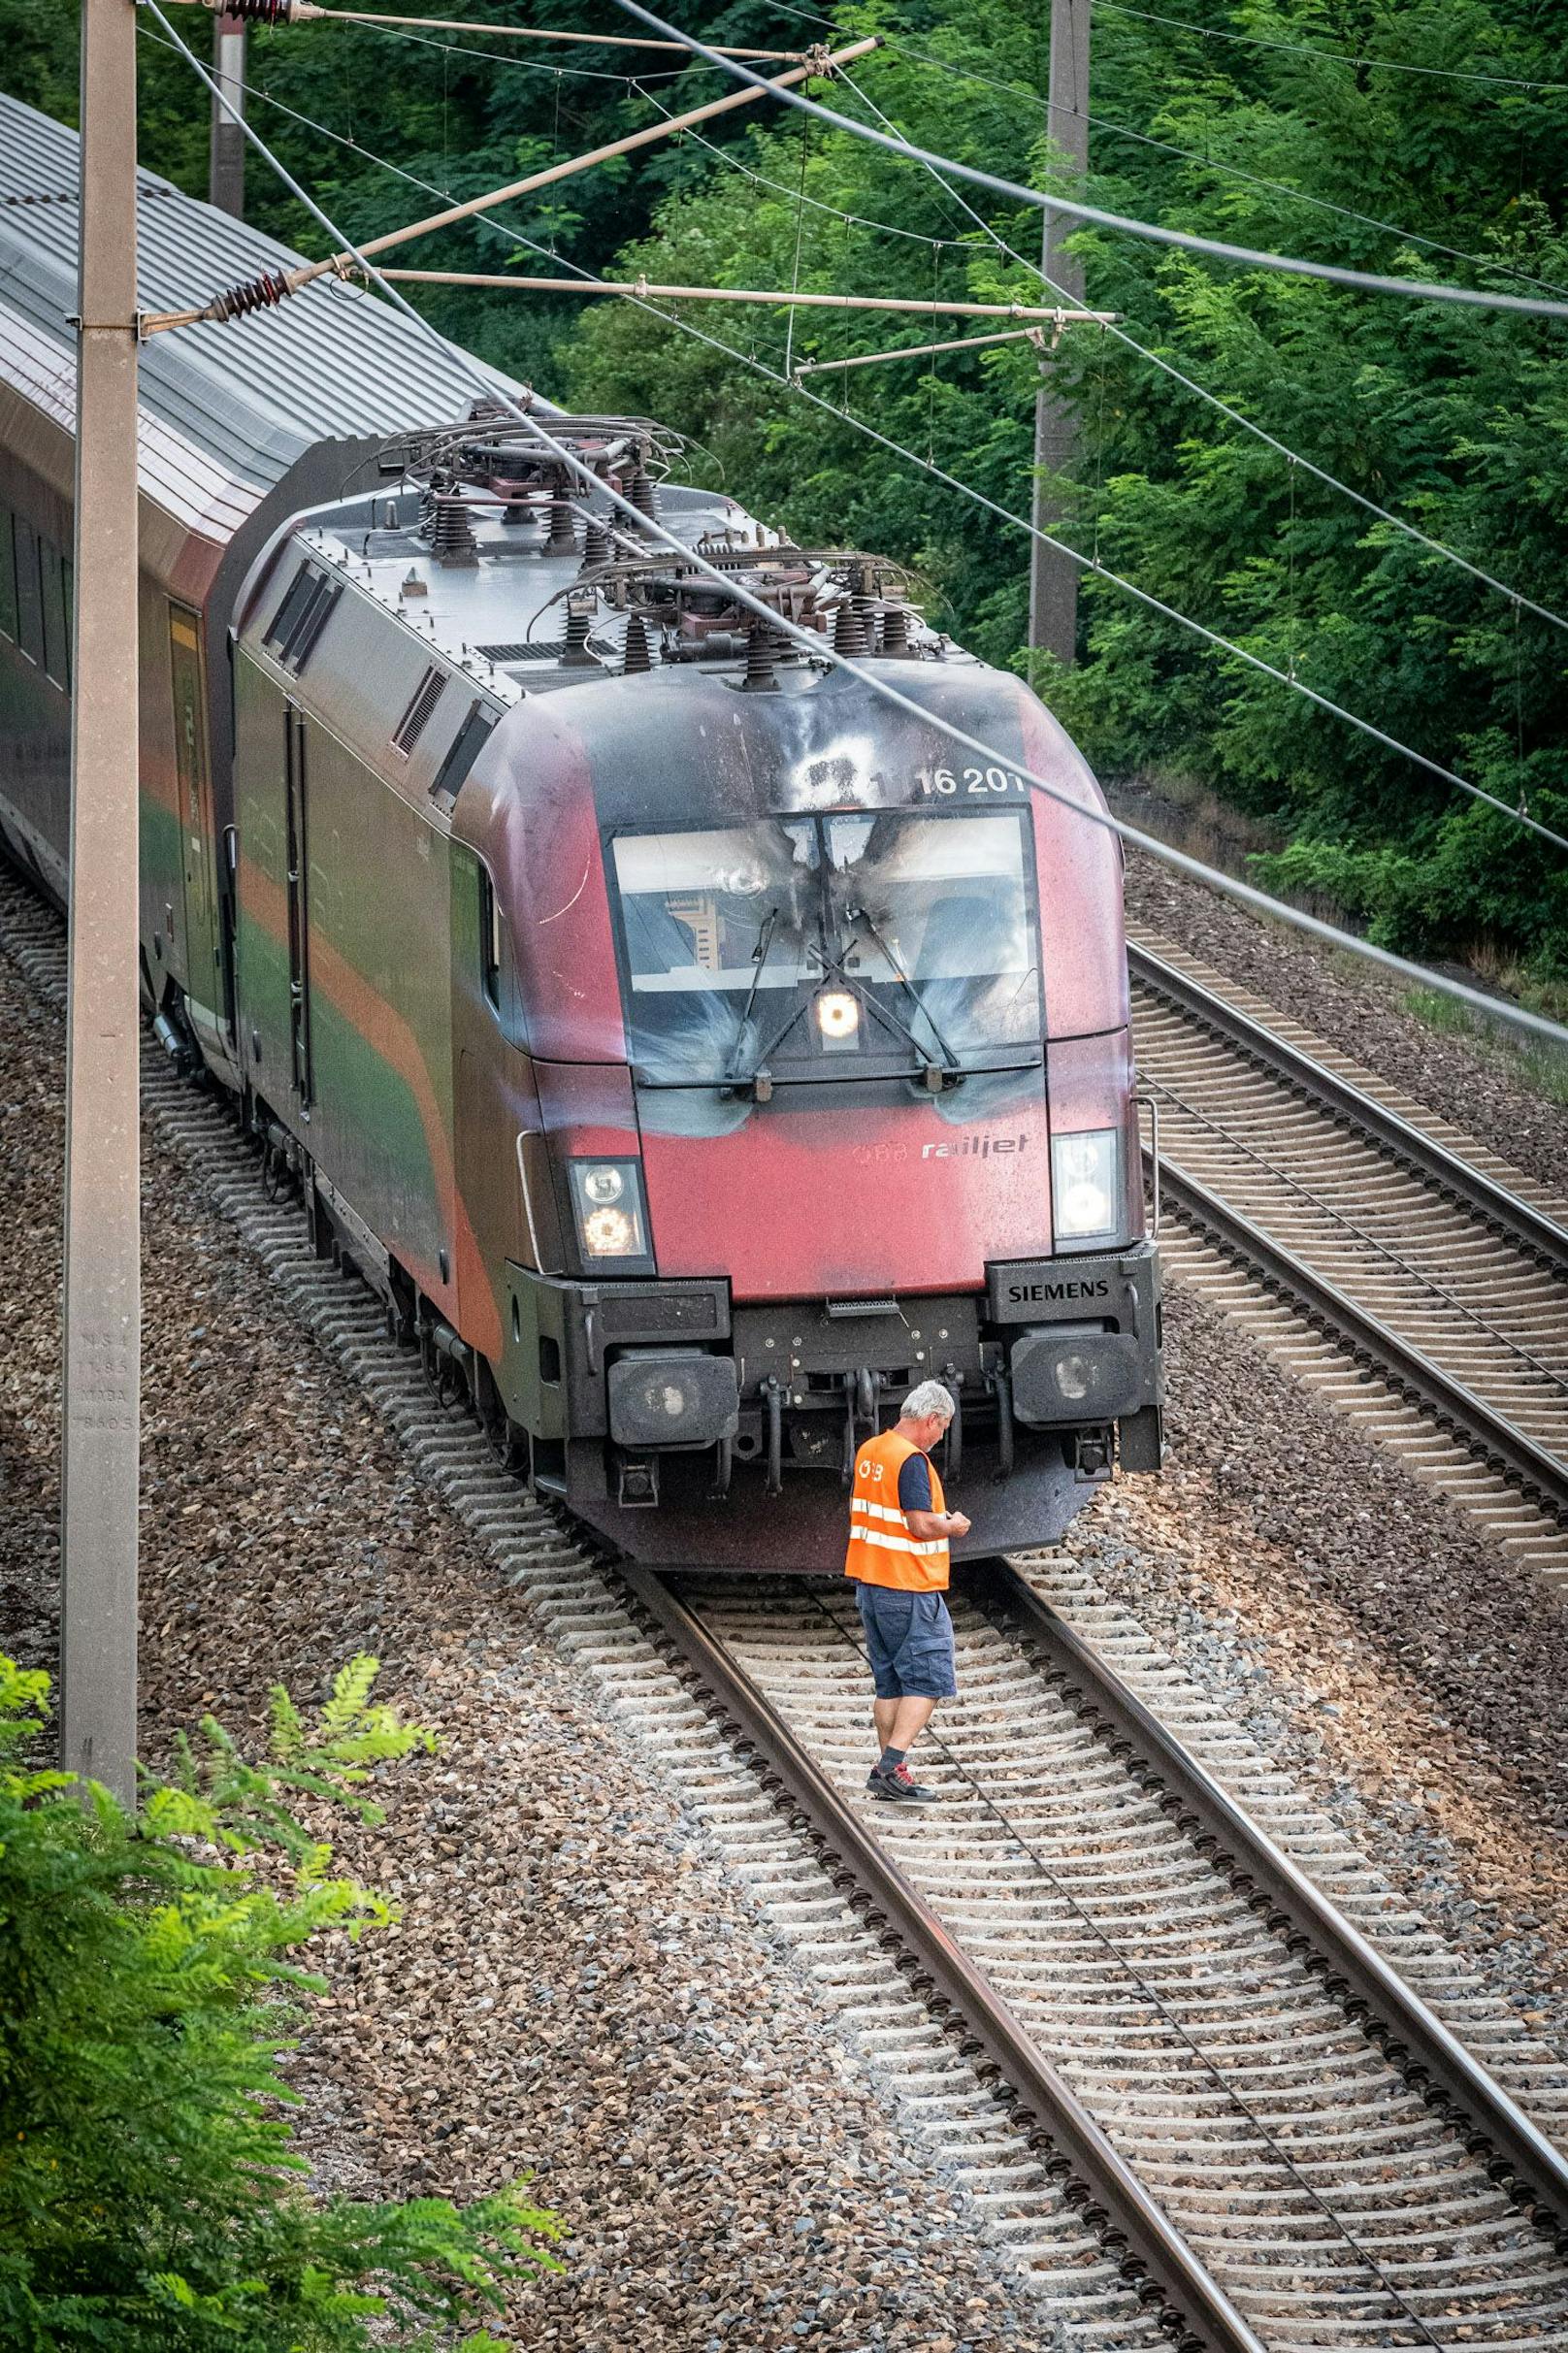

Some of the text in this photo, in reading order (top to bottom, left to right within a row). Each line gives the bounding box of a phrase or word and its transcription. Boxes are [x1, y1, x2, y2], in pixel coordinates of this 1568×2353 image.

[963, 767, 1025, 794] 201
[921, 1133, 1029, 1160] railjet
[1009, 1280, 1109, 1303] SIEMENS
